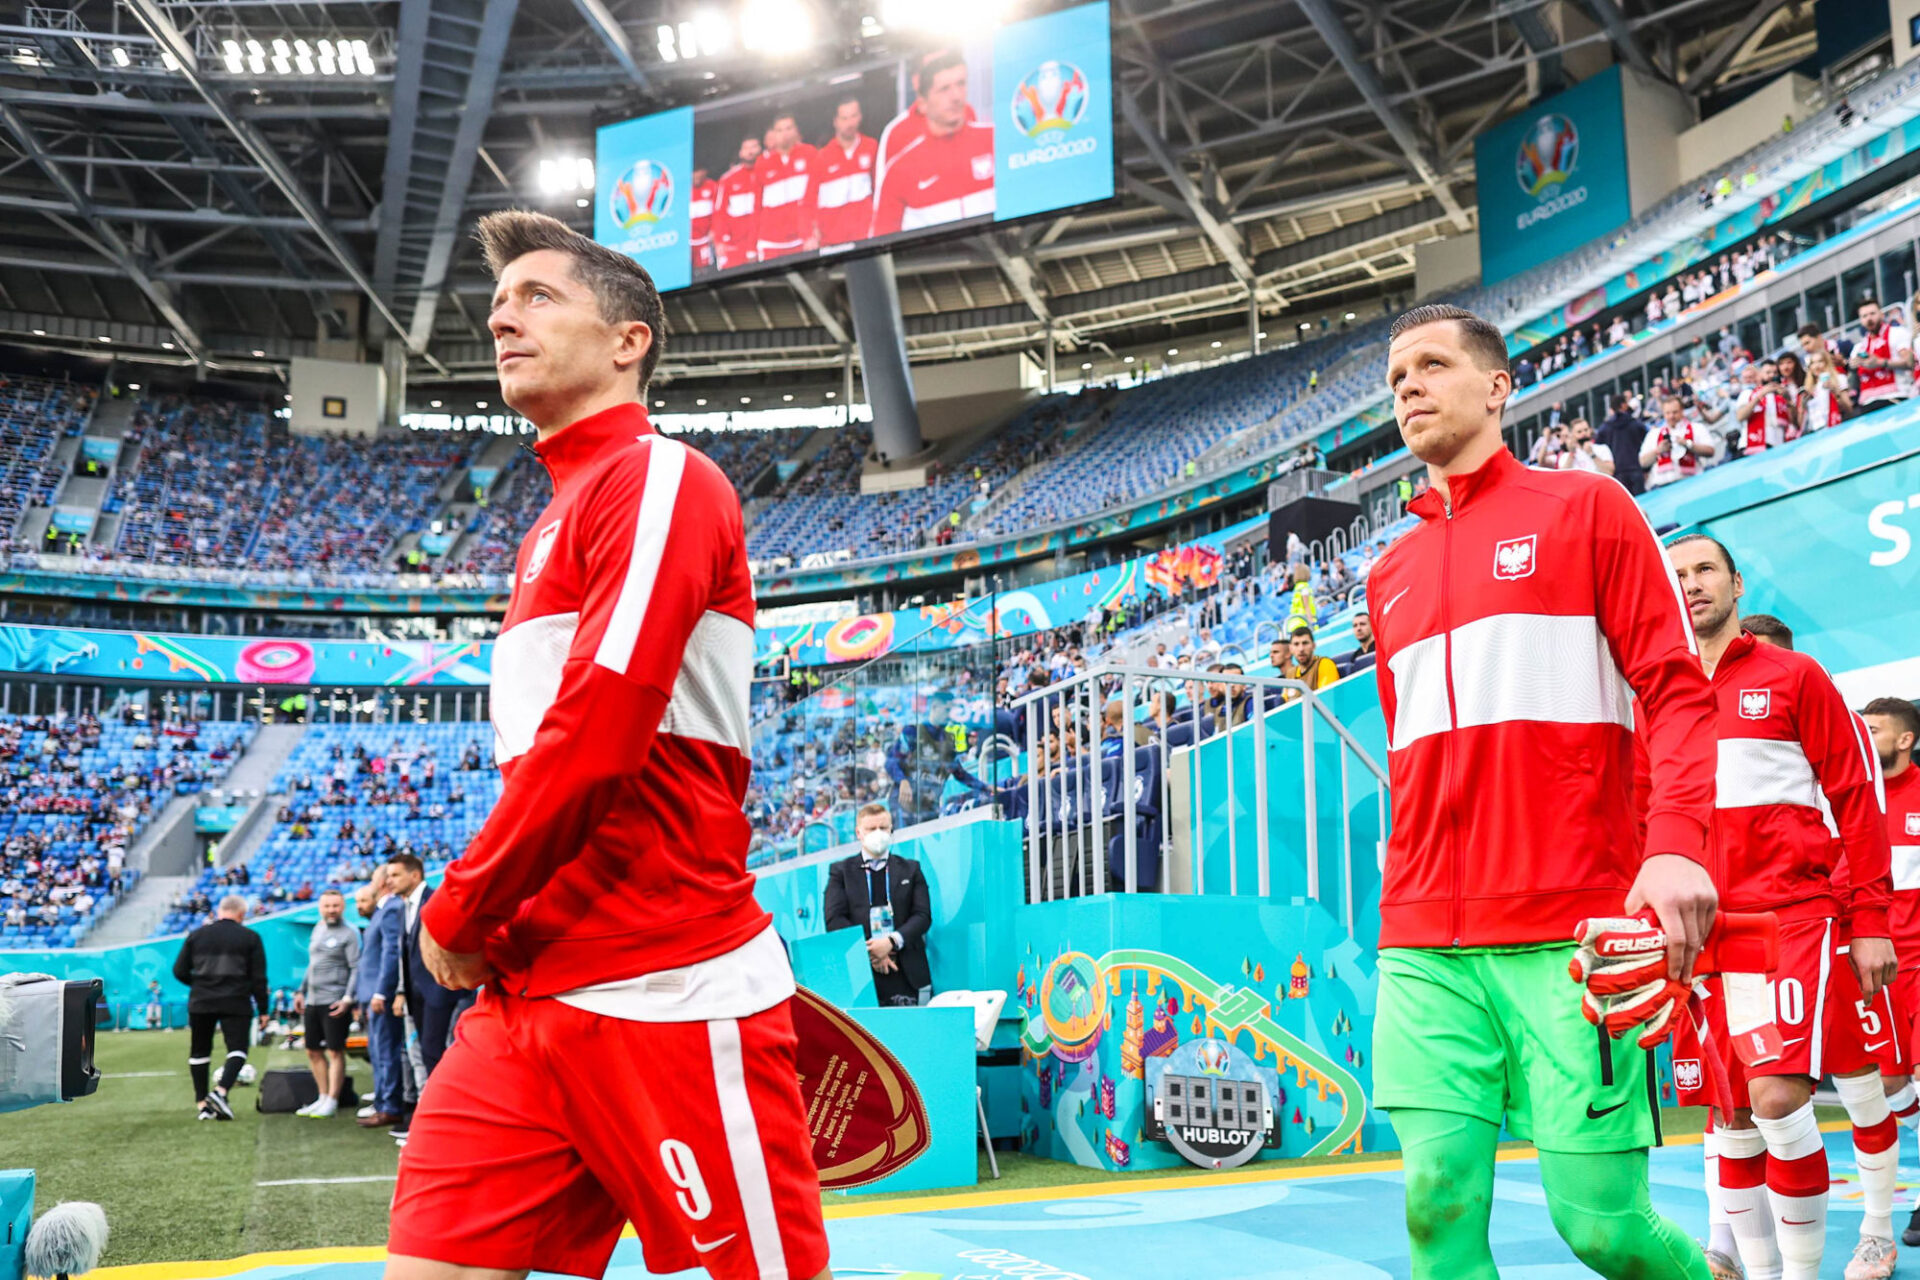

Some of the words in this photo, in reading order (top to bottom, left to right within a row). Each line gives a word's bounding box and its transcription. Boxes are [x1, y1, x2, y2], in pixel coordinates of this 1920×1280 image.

[1007, 136, 1097, 169] EURO2020
[1516, 185, 1588, 230] EURO2020
[1868, 493, 1920, 567] S
[1766, 978, 1805, 1025] 10
[1855, 999, 1882, 1035] 5
[823, 1118, 837, 1139] Poland
[1182, 1127, 1251, 1145] HUBLOT
[659, 1138, 713, 1221] 9
